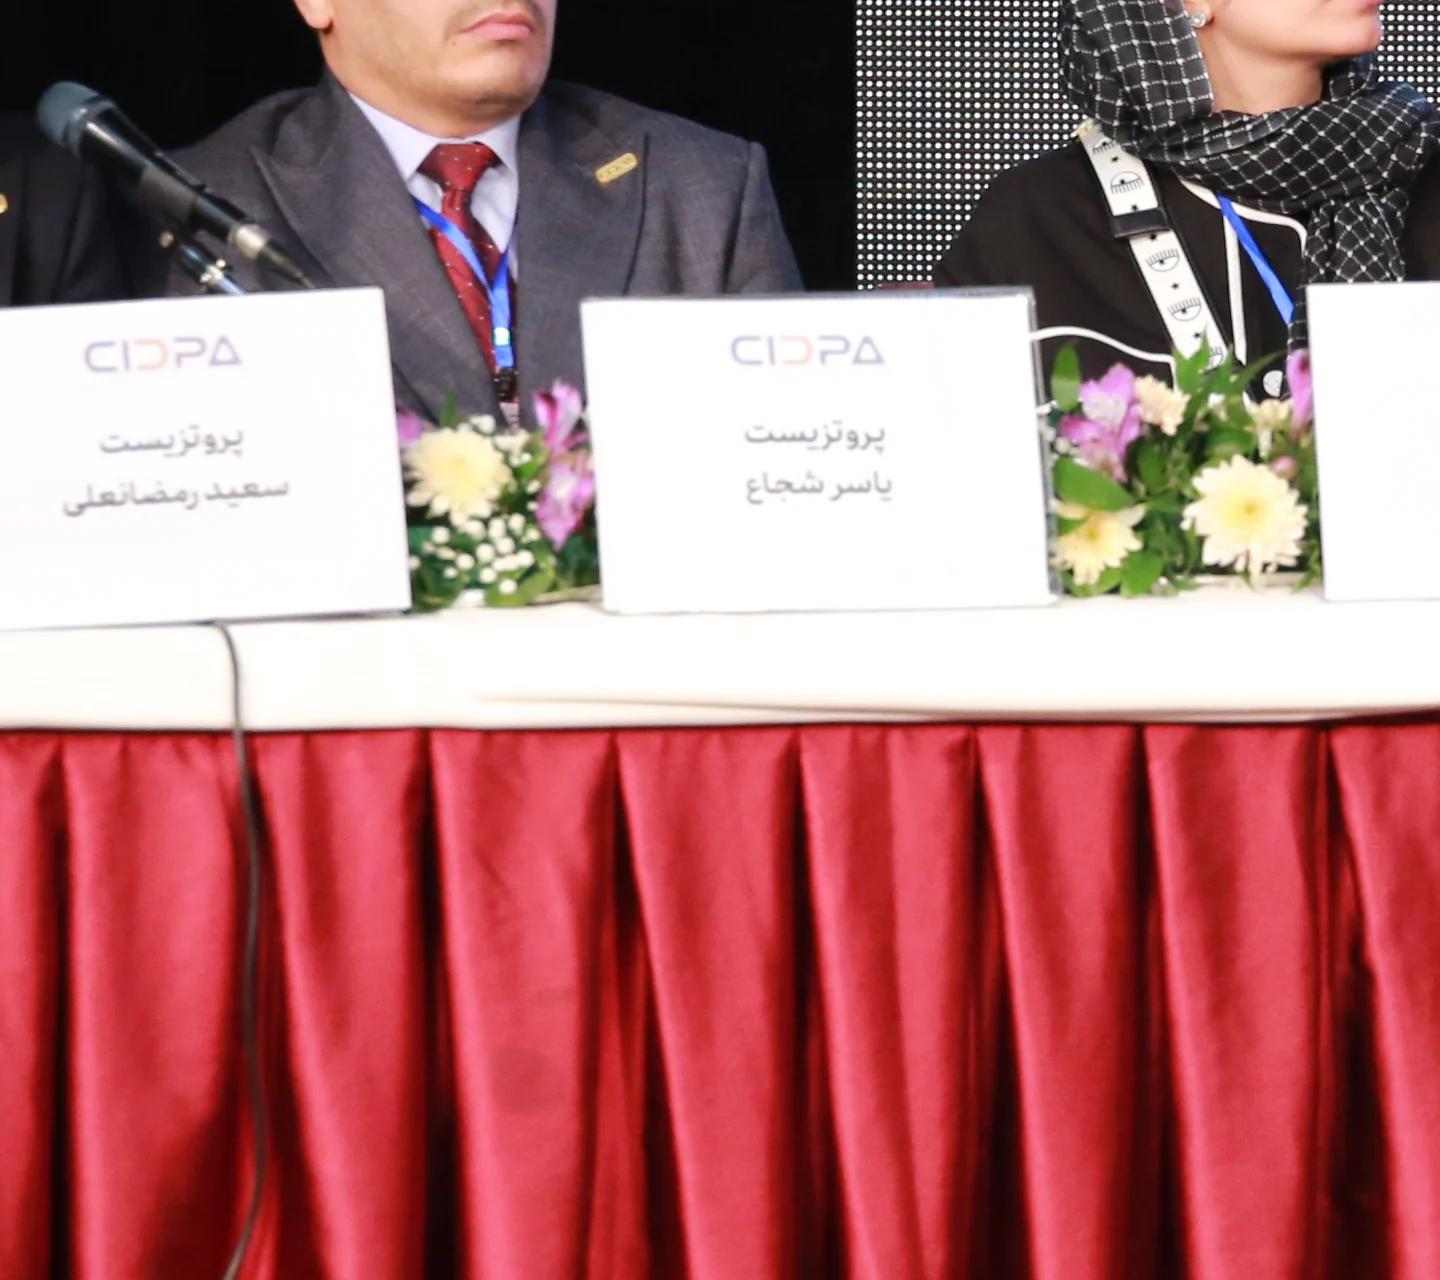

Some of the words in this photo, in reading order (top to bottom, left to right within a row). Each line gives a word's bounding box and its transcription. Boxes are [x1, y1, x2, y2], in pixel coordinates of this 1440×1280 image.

[83, 334, 242, 373] CIDPA
[730, 335, 886, 365] CIDPA
[99, 424, 243, 458] پروتزیست
[744, 419, 886, 455] پروتزیست
[204, 480, 289, 509] سعید
[746, 469, 824, 505] شجاع
[829, 470, 892, 502] یاسر
